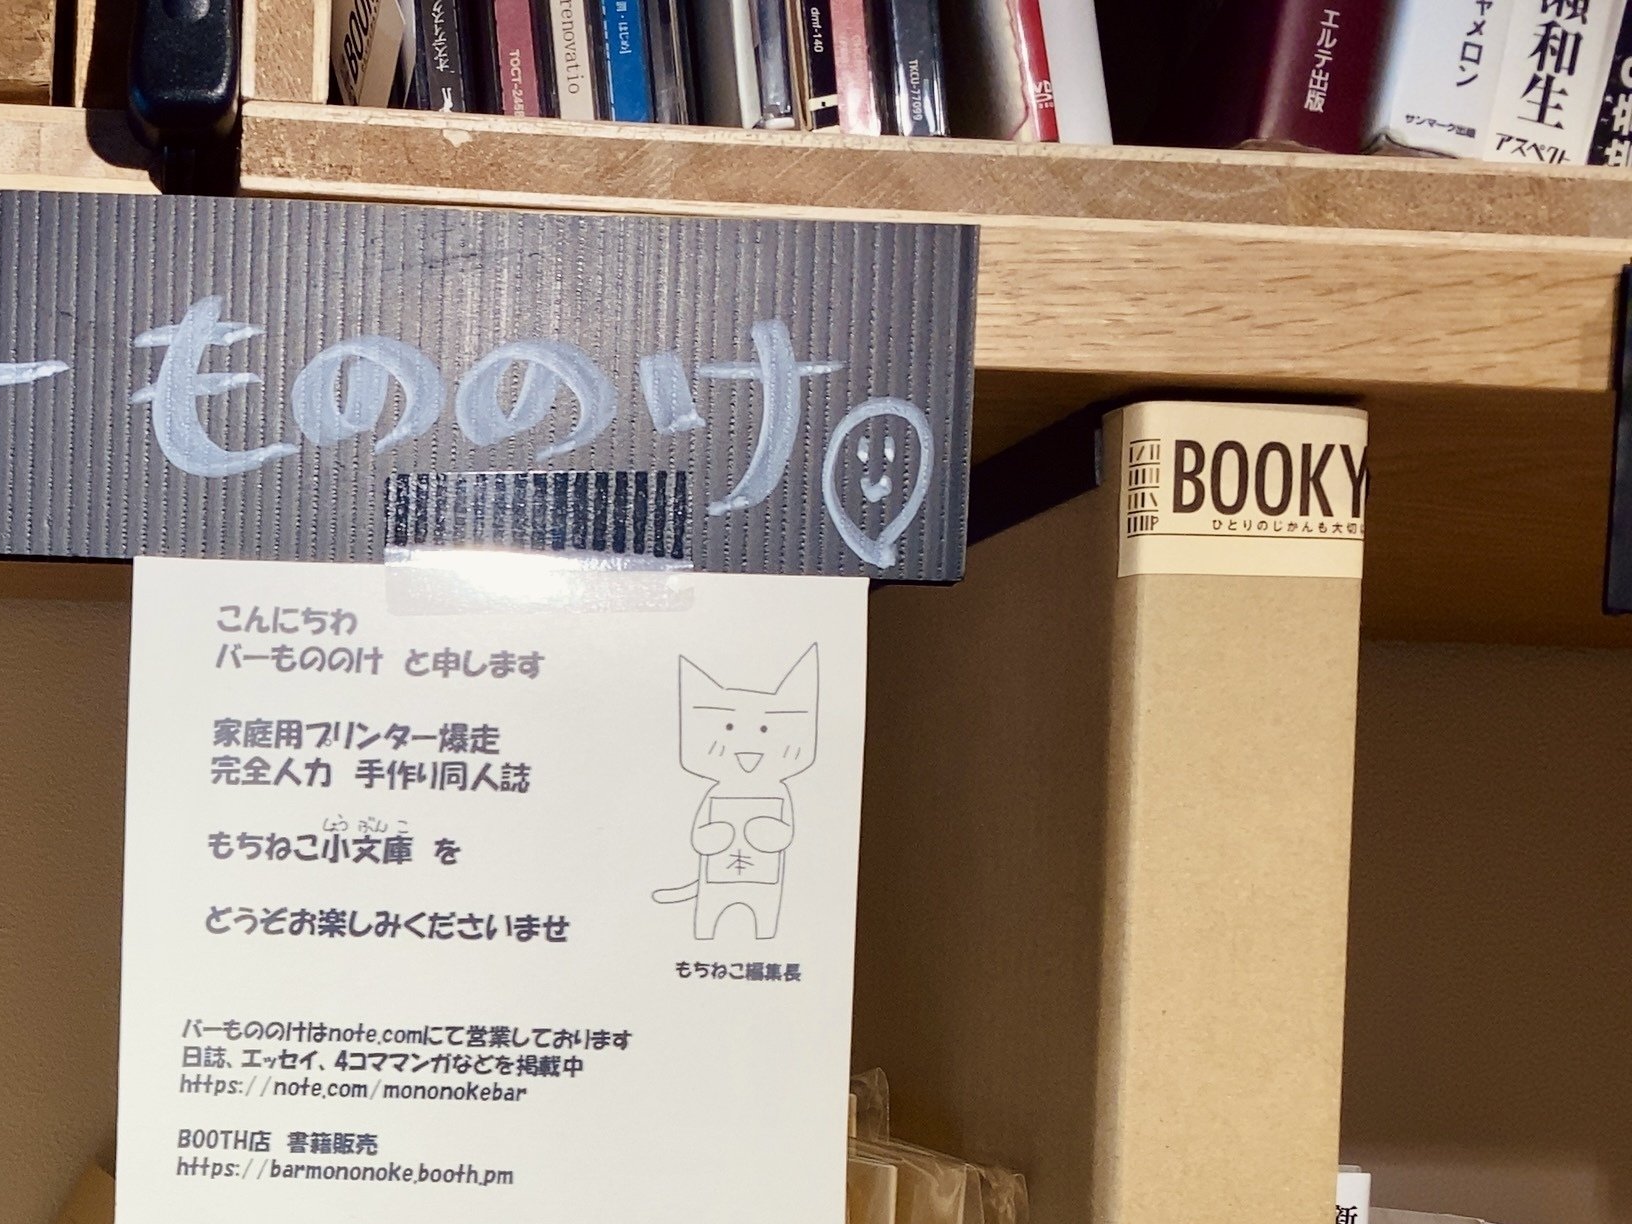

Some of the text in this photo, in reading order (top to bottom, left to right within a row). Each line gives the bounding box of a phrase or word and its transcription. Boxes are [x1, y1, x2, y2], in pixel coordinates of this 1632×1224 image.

[810, 7, 824, 53] dmf-140
[1304, 9, 1340, 113] エルテ出版
[1172, 438, 1368, 519] BOOKY
[216, 604, 358, 636] こんにちわ
[215, 643, 546, 679] バーもののけ と申します
[212, 717, 501, 754] 家庭用プリンター爆走
[210, 755, 531, 793] 完全人力 手作り同人誌
[207, 830, 462, 865] もちねこ小文庫 を
[204, 906, 571, 943] どうぞお楽しみくださいませ
[675, 961, 801, 982] もちねこ編集長
[181, 1018, 634, 1051] バーもののけはnote.comにて営業しております
[181, 1046, 585, 1078] 日誌、エッセイ、4コママンガなどを掲載中
[179, 1074, 528, 1102] https://note.com/mononokebar
[176, 1129, 380, 1156] BOOTH店 書籍販売
[176, 1159, 514, 1187] https://barmononoke.booth.pm
